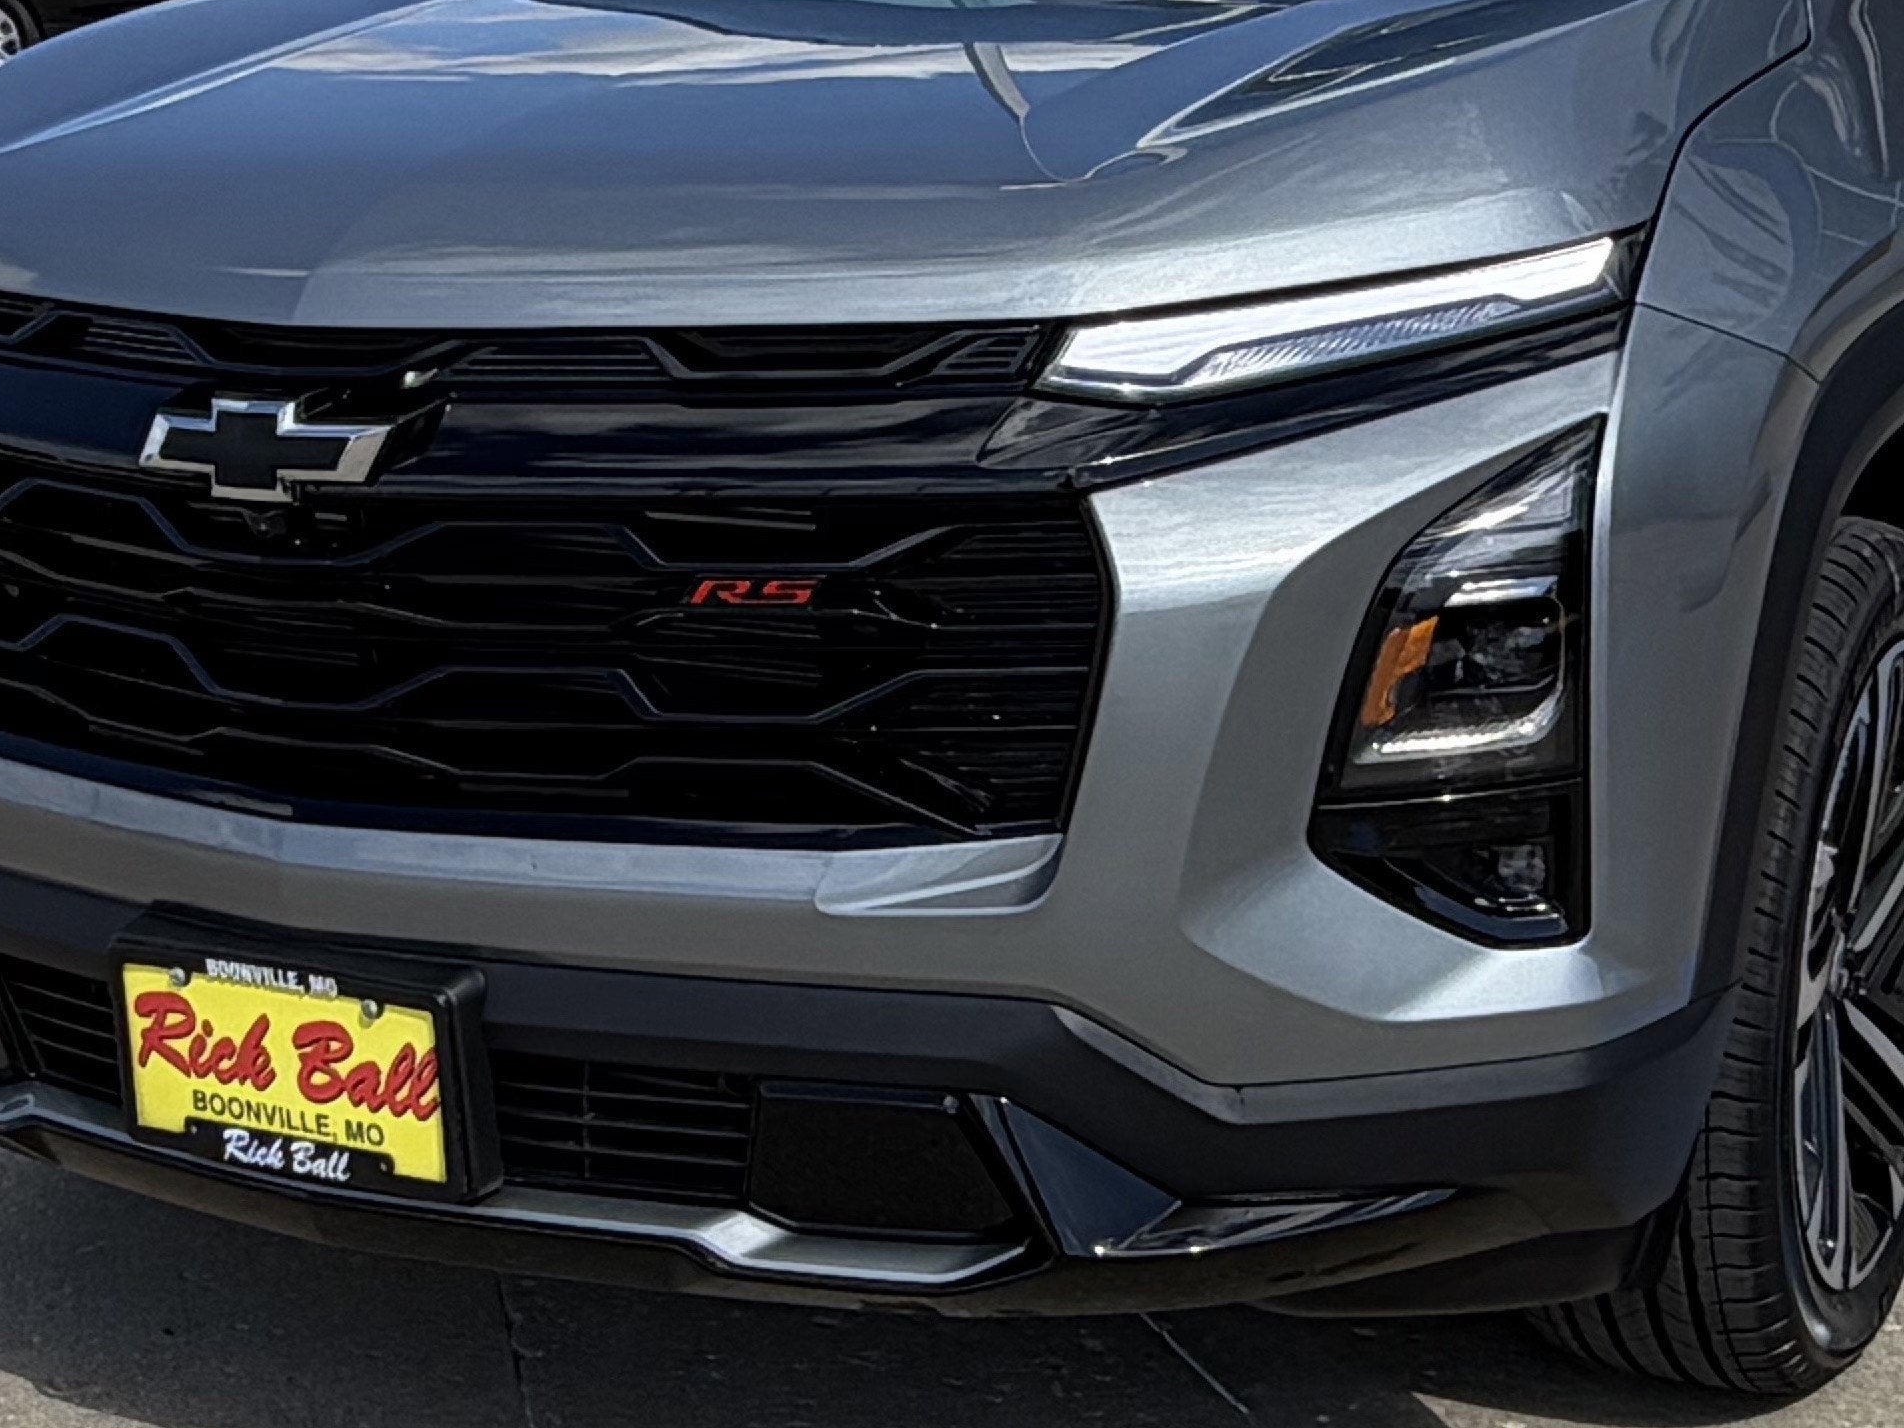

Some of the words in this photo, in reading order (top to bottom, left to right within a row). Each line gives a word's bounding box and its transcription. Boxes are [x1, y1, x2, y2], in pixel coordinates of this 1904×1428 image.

[690, 580, 819, 604] RS
[309, 974, 338, 998] MO
[133, 990, 276, 1091] Rick
[292, 1020, 440, 1121] Ball
[192, 1089, 338, 1142] BOONVILLE,
[345, 1119, 385, 1146] MO
[222, 1128, 285, 1170] Rick
[290, 1140, 352, 1182] Ball
